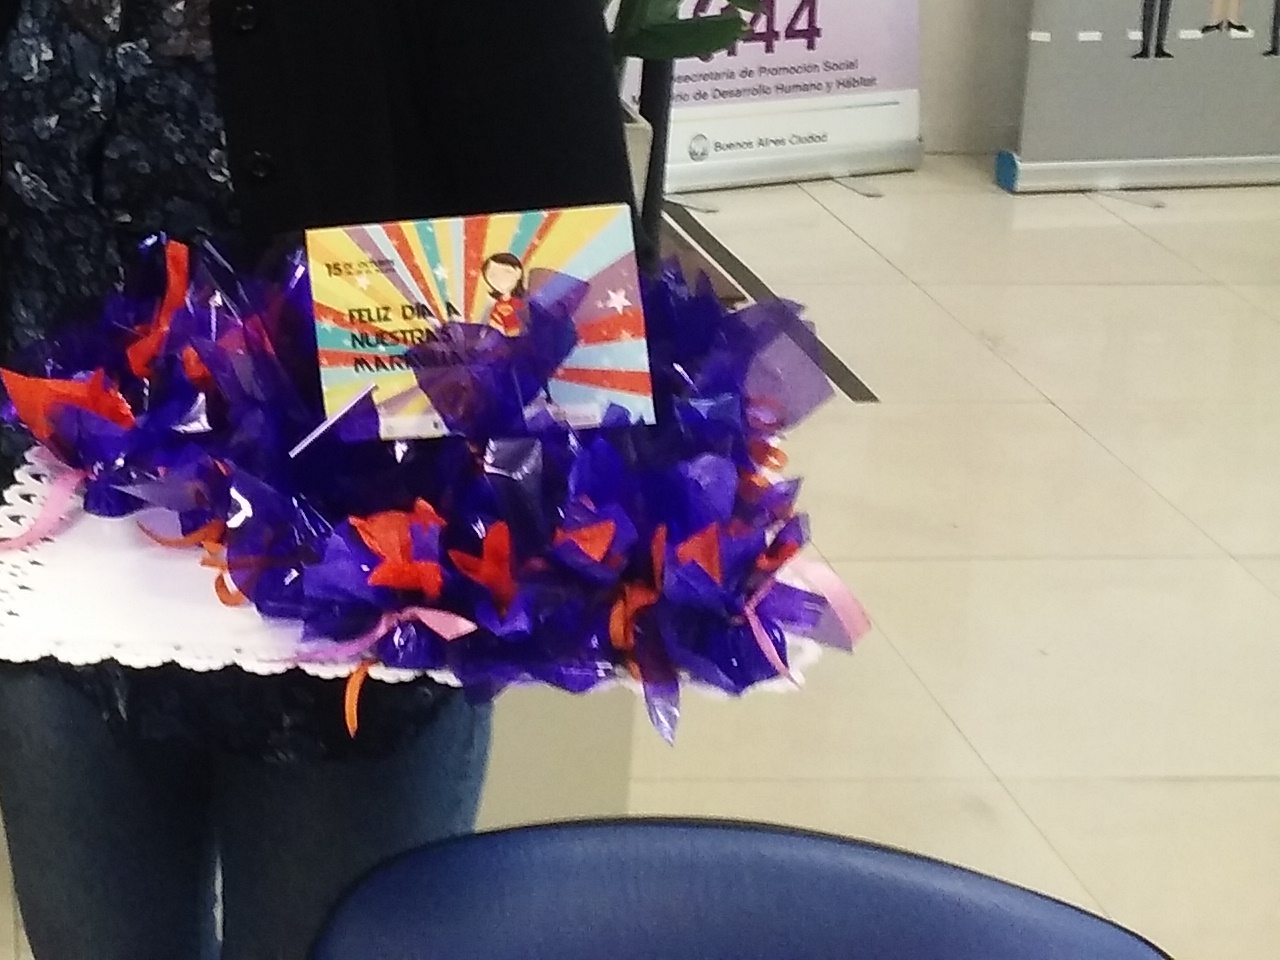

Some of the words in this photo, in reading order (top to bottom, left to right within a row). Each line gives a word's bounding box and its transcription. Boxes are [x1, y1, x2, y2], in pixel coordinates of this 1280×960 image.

[739, 66, 755, 79] de
[324, 261, 342, 277] 15
[348, 306, 392, 324] FELIZ
[445, 300, 462, 317] A
